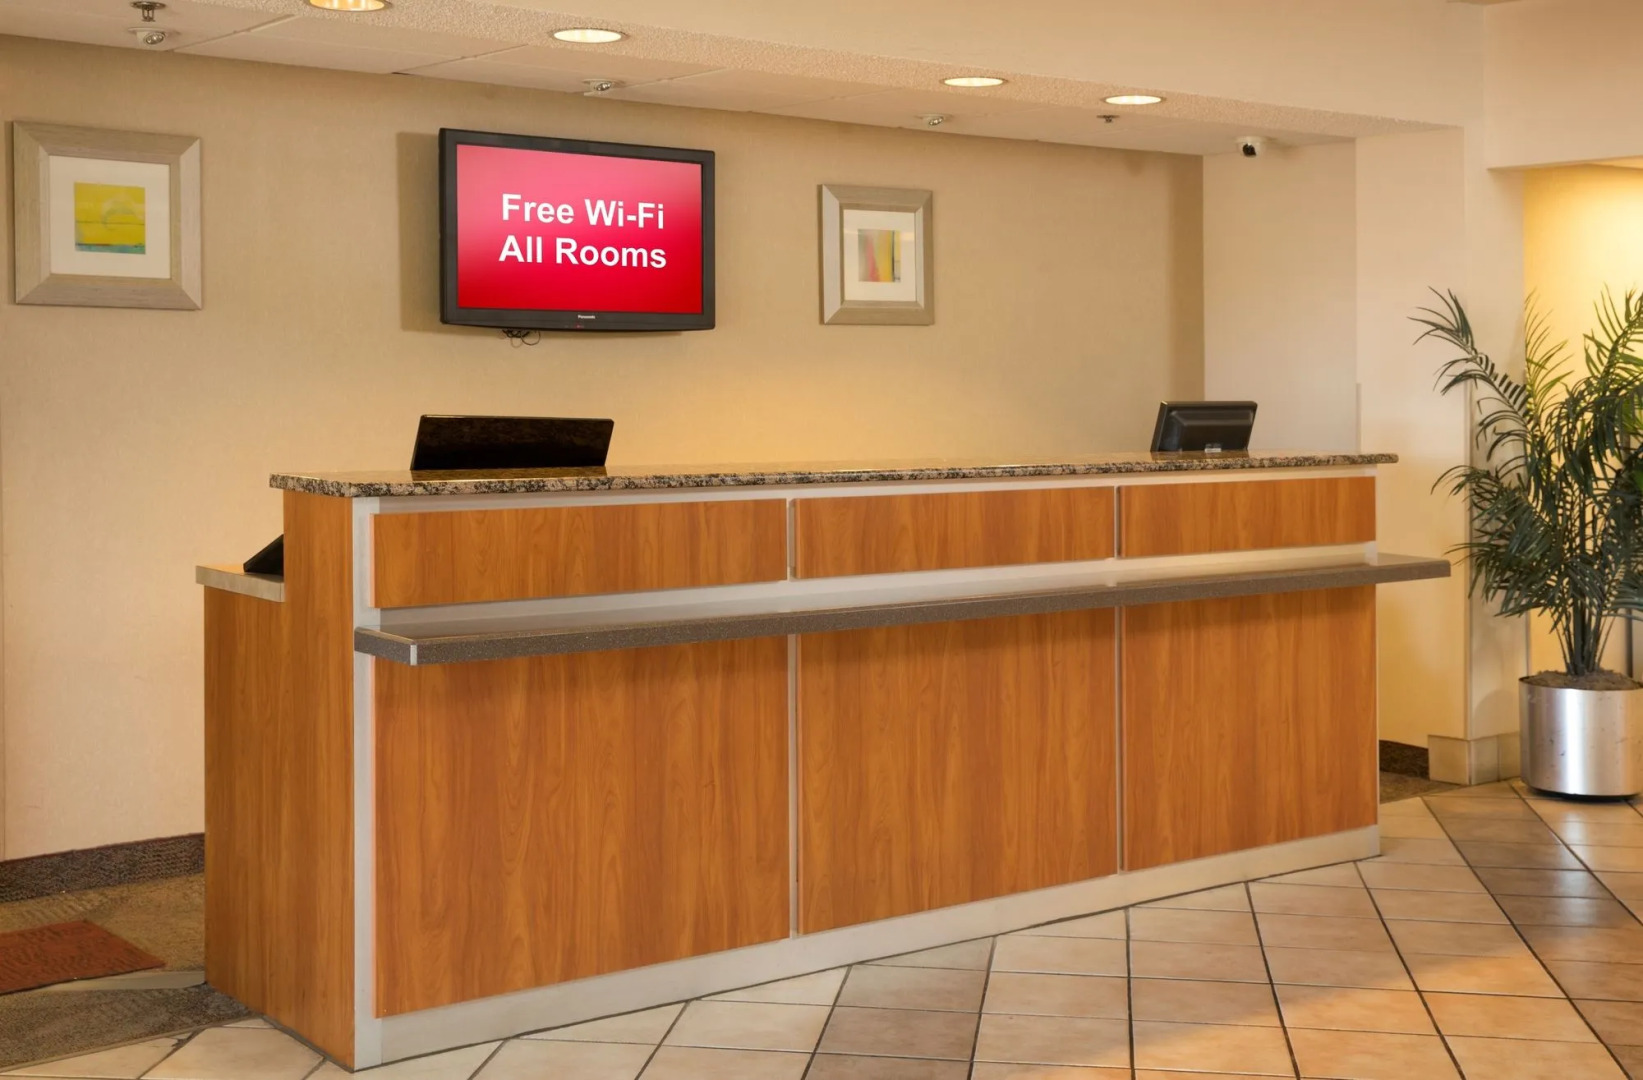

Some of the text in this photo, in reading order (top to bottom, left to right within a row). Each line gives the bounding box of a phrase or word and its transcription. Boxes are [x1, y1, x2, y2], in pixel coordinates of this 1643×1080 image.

[502, 193, 664, 229] Free Wi-Fi
[498, 234, 667, 268] All Rooms
